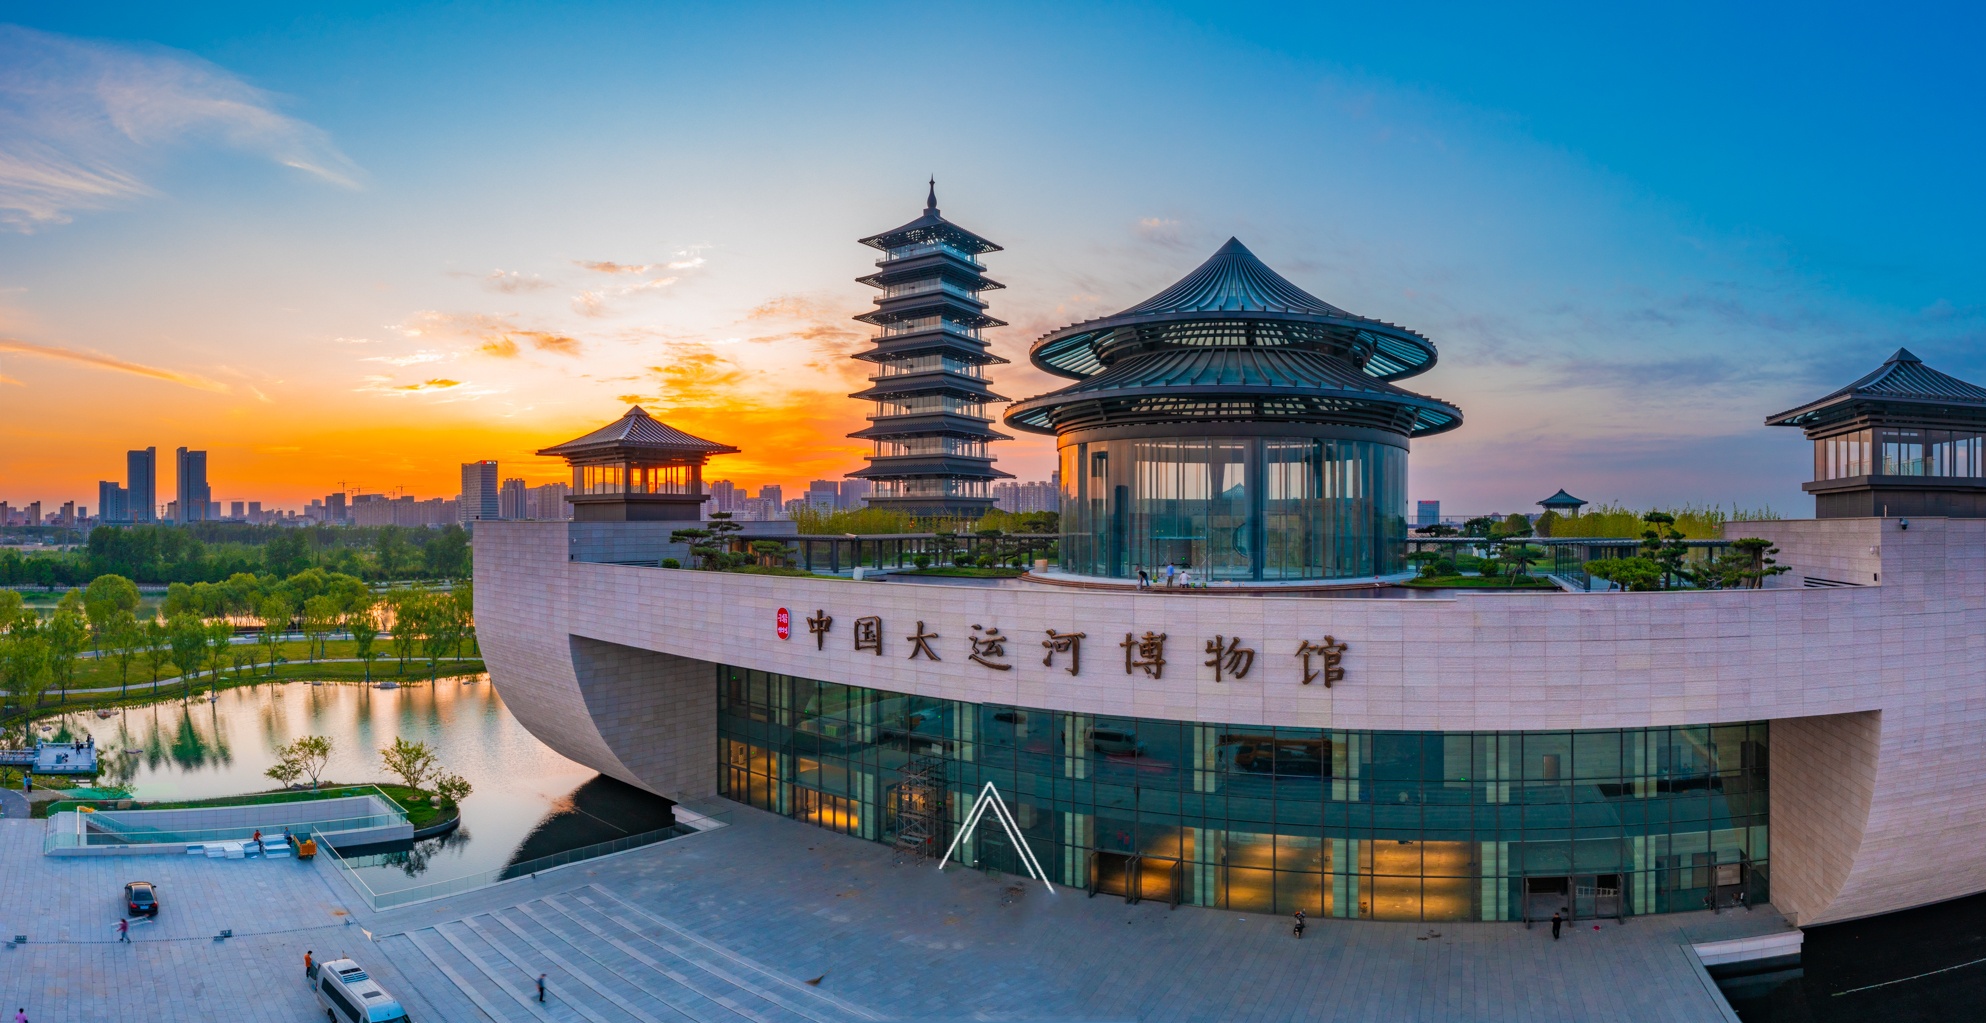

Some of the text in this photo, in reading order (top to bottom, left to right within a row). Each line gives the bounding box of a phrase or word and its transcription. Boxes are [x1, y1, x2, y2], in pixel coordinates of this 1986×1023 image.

[806, 608, 1348, 689] 中国大运河博物馆
